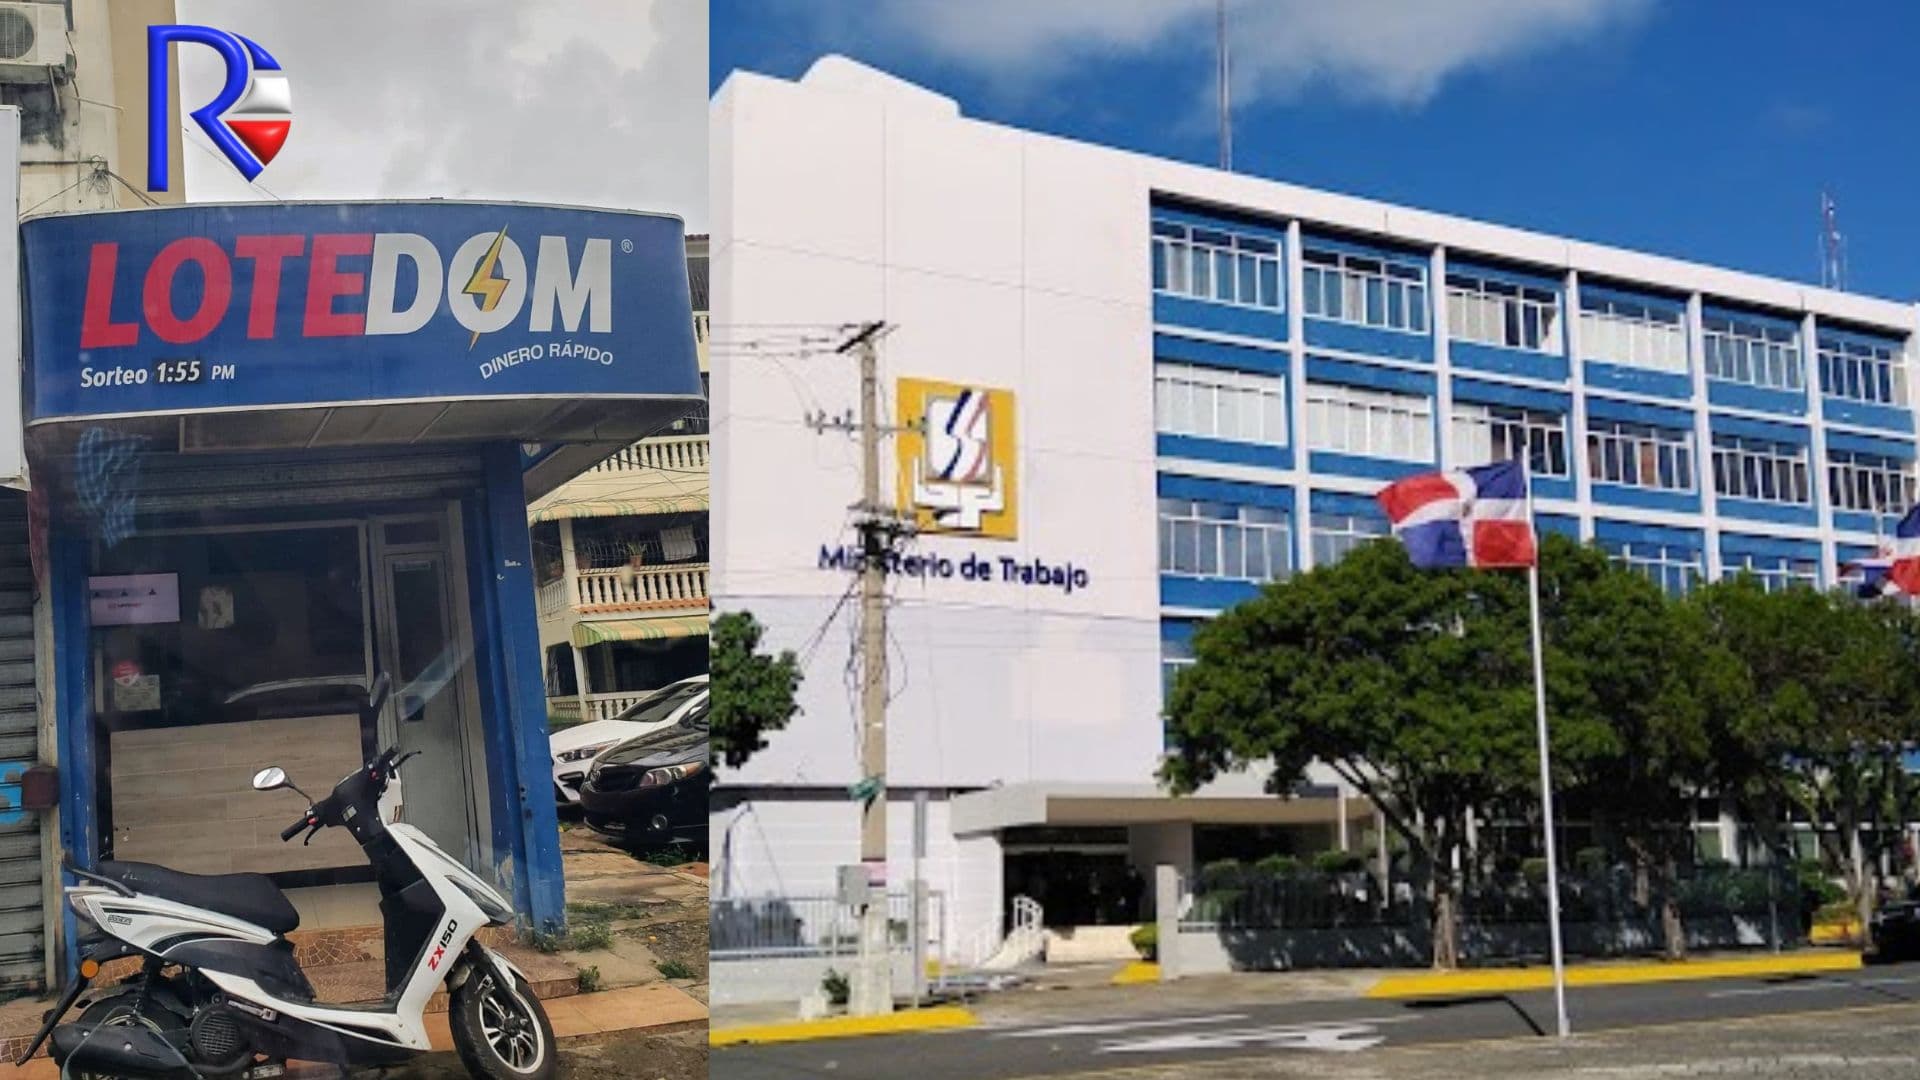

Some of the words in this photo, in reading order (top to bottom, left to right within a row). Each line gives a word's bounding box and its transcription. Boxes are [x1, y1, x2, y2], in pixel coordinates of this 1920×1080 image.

[80, 229, 612, 349] LOTEDOM
[80, 366, 148, 388] Sorteo
[157, 360, 200, 383] 1:55
[211, 364, 235, 380] PM
[479, 344, 543, 379] DINERO
[549, 339, 614, 366] RÁPIDO
[960, 552, 991, 581] de
[998, 555, 1087, 594] Trabajo
